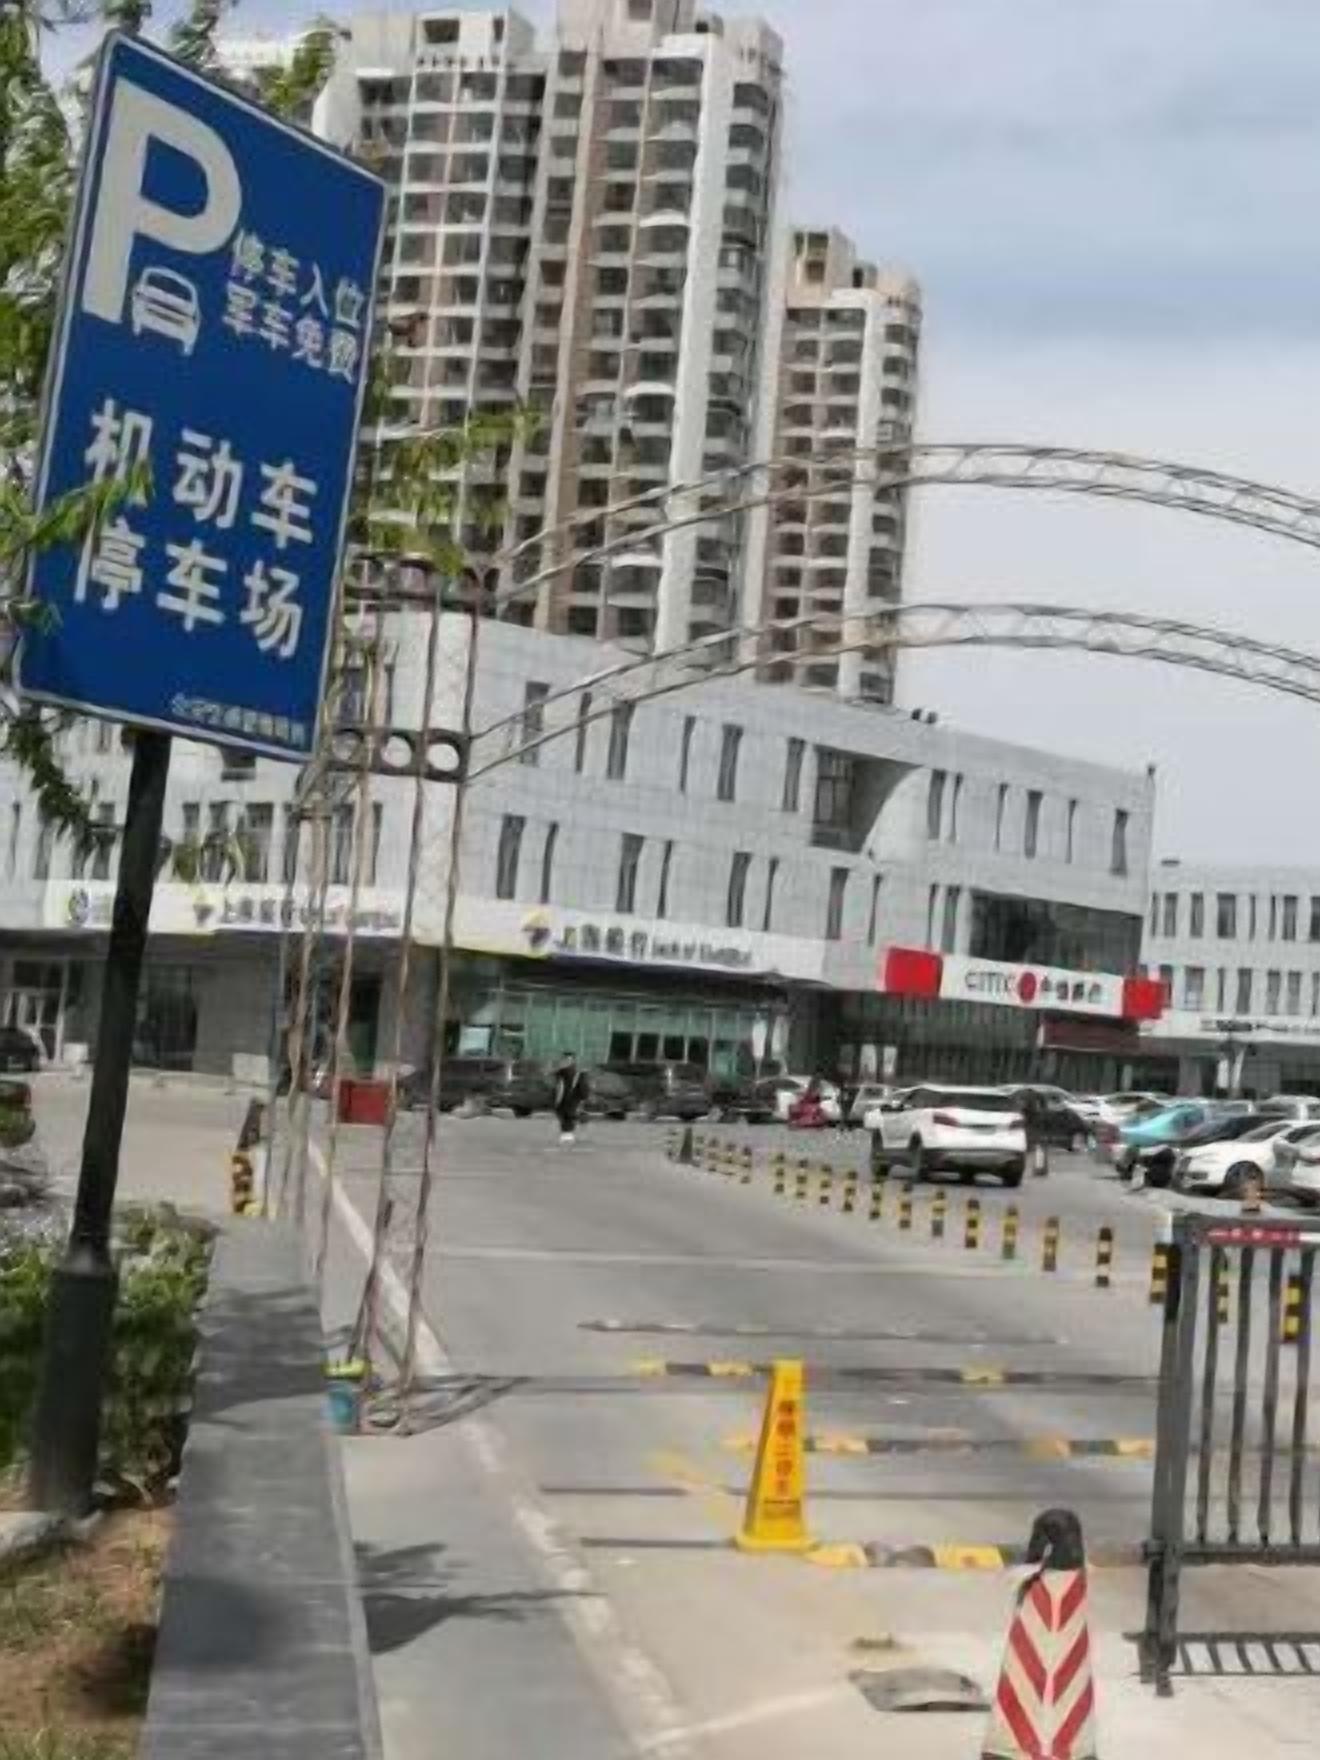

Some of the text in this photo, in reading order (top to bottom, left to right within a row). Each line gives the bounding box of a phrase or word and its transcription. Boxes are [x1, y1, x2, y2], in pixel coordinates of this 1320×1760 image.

[82, 77, 242, 323] P
[230, 229, 365, 328] 停车入位
[84, 397, 318, 549] 机动车
[74, 508, 303, 659] 停车场
